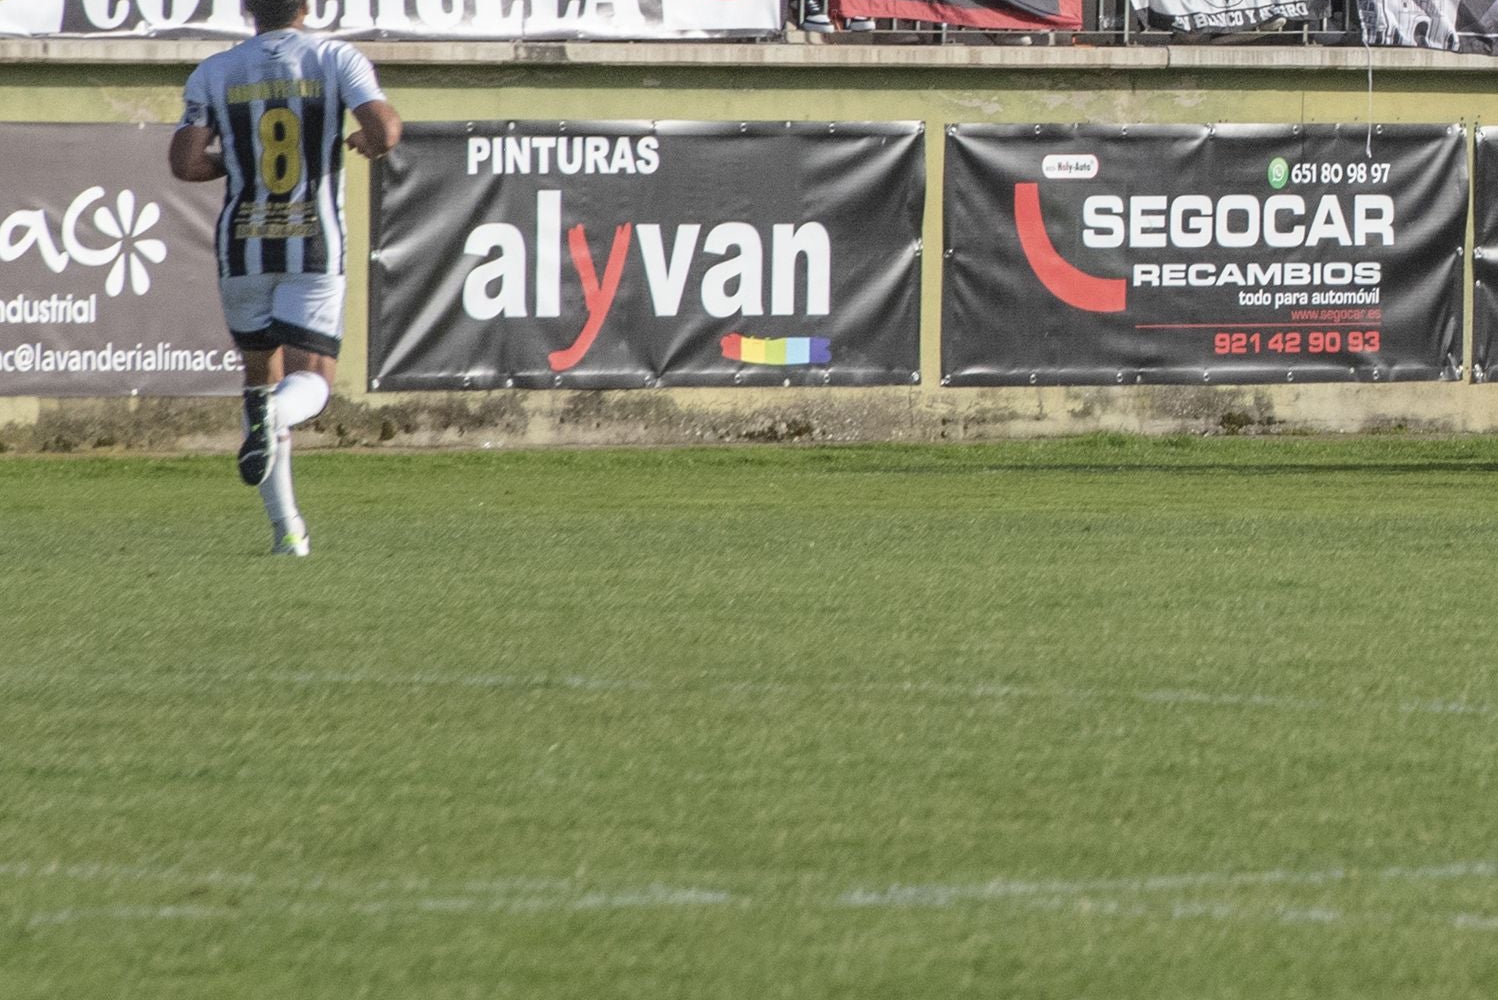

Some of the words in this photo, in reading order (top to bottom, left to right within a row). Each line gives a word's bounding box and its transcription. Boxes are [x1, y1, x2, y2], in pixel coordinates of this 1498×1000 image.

[1246, 9, 1256, 24] Y
[258, 107, 301, 195] 8
[467, 136, 660, 175] PINTURAS
[1291, 163, 1317, 183] 651
[1320, 163, 1343, 183] 80
[1346, 163, 1368, 183] 98
[1371, 162, 1390, 183] 97
[1082, 194, 1394, 248] SEGOCAR
[462, 190, 830, 371] alyvan
[1132, 262, 1381, 287] RECAMBIOS
[1238, 289, 1271, 305] todo
[1274, 291, 1308, 309] para
[1311, 287, 1380, 305] automóvil
[1291, 308, 1381, 323] www.segocar.es
[1214, 332, 1261, 354] 921
[1267, 331, 1301, 353] 42
[1308, 331, 1341, 353] 90
[1347, 330, 1380, 353] 93
[0, 342, 246, 372] c@lavanderialimac.e
